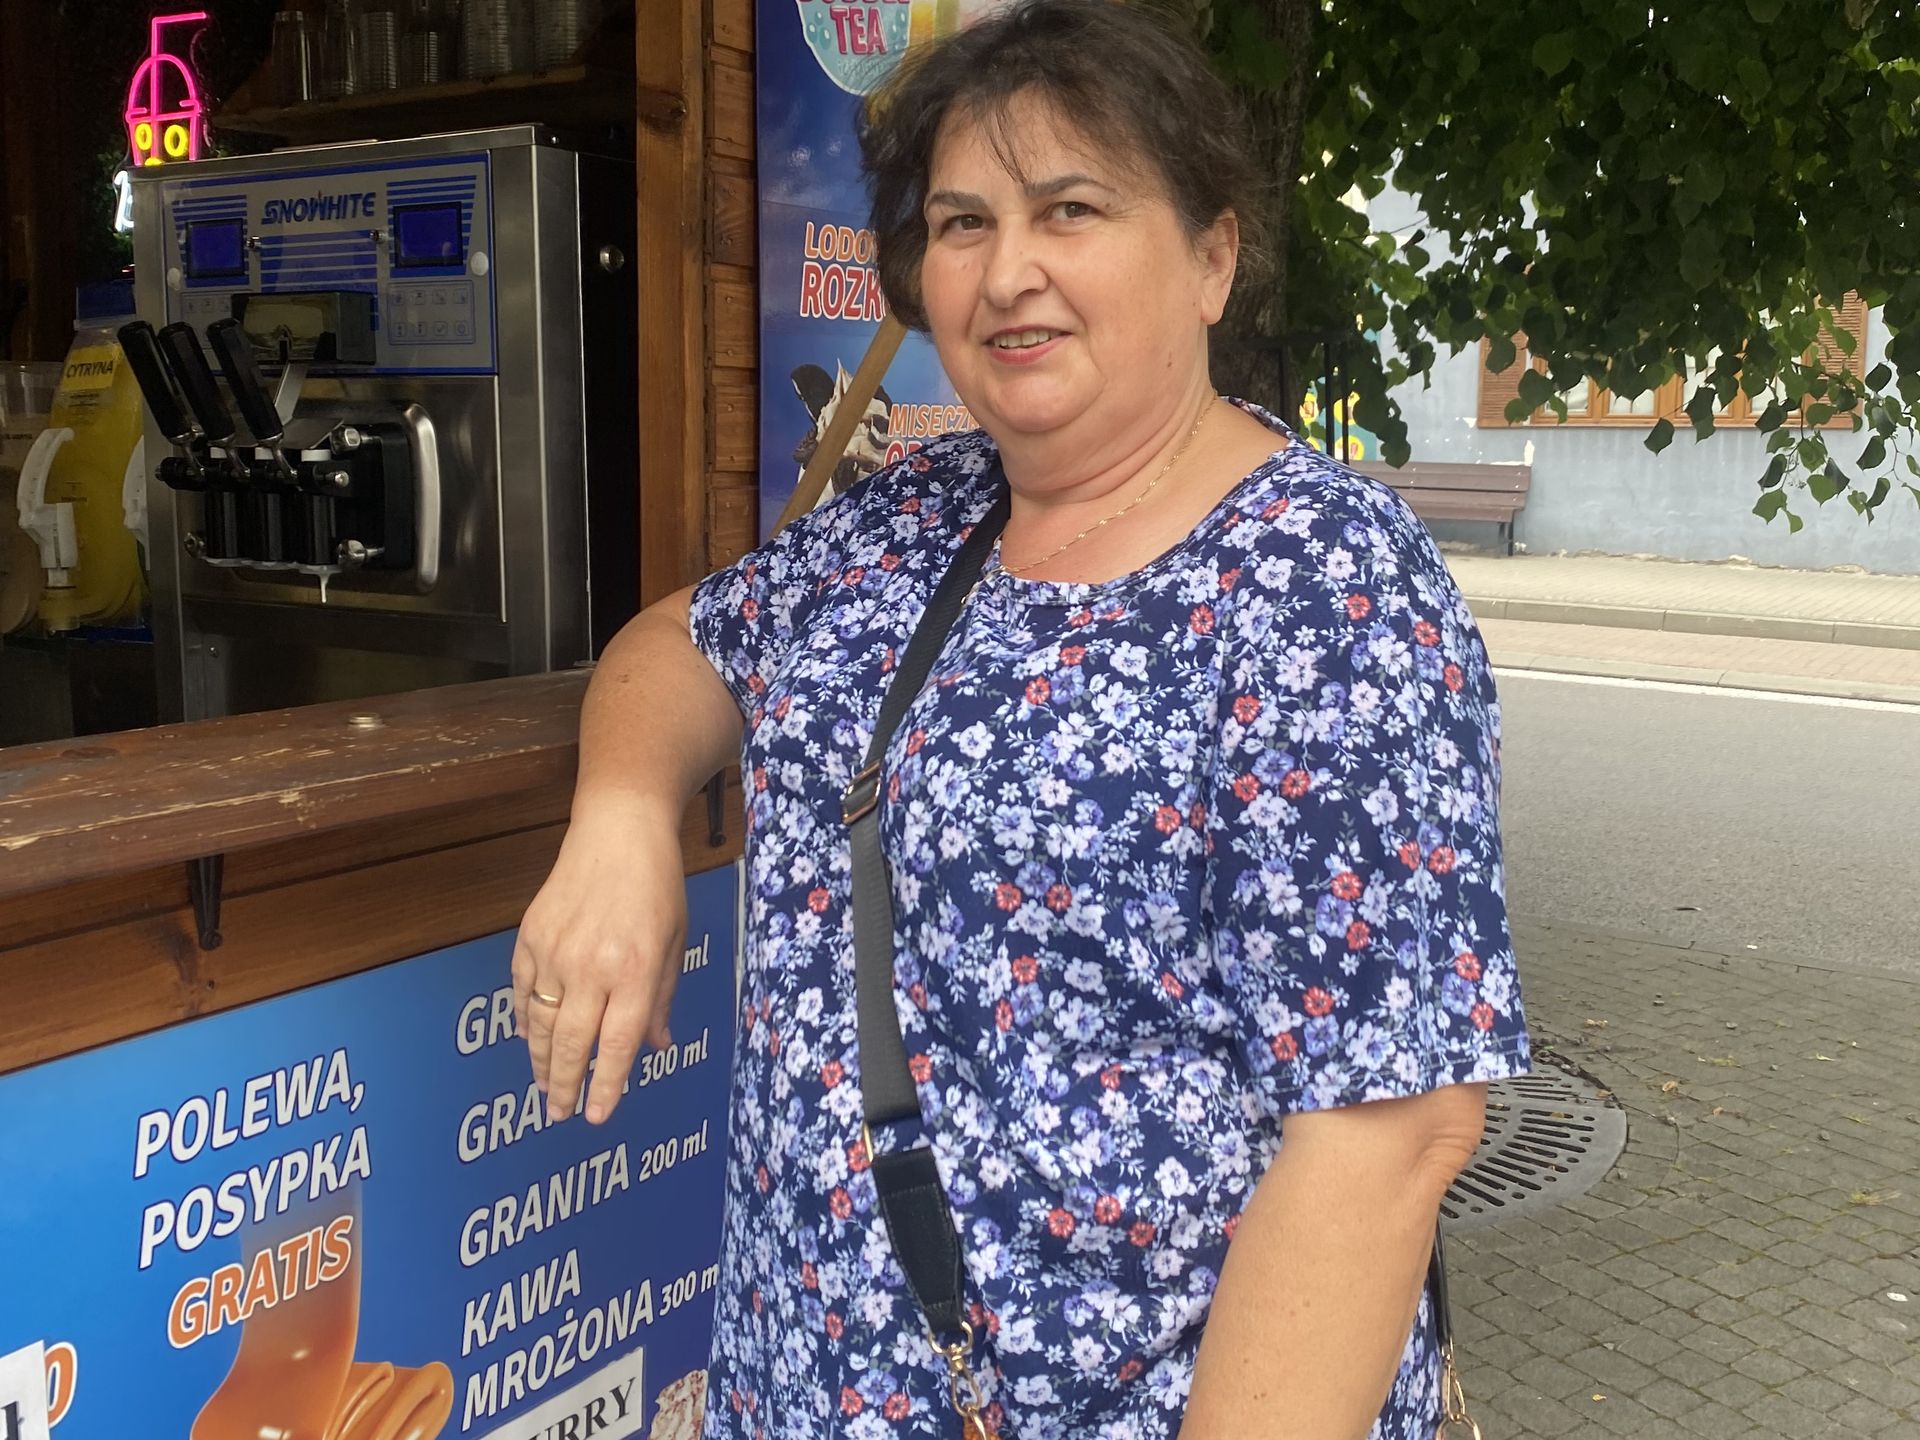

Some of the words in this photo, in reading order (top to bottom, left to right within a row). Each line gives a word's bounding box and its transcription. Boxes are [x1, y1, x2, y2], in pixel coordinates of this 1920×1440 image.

[830, 7, 888, 55] TEA
[261, 189, 377, 225] SNOWHITE
[804, 221, 879, 264] LODO
[800, 261, 886, 322] ROZK
[65, 359, 114, 379] CYTRYNA
[638, 1043, 679, 1088] 300
[682, 1027, 709, 1069] ml
[133, 1048, 366, 1179] POLEWA,
[138, 1125, 372, 1271] POSYPKA
[459, 1142, 630, 1267] GRANITA
[638, 1137, 678, 1182] 200
[681, 1119, 708, 1161] ml
[166, 1214, 354, 1350] GRATIS
[461, 1248, 581, 1357] KAWA
[461, 1278, 655, 1433] MROŻONA
[659, 1270, 698, 1317] 300
[700, 1263, 720, 1294] m
